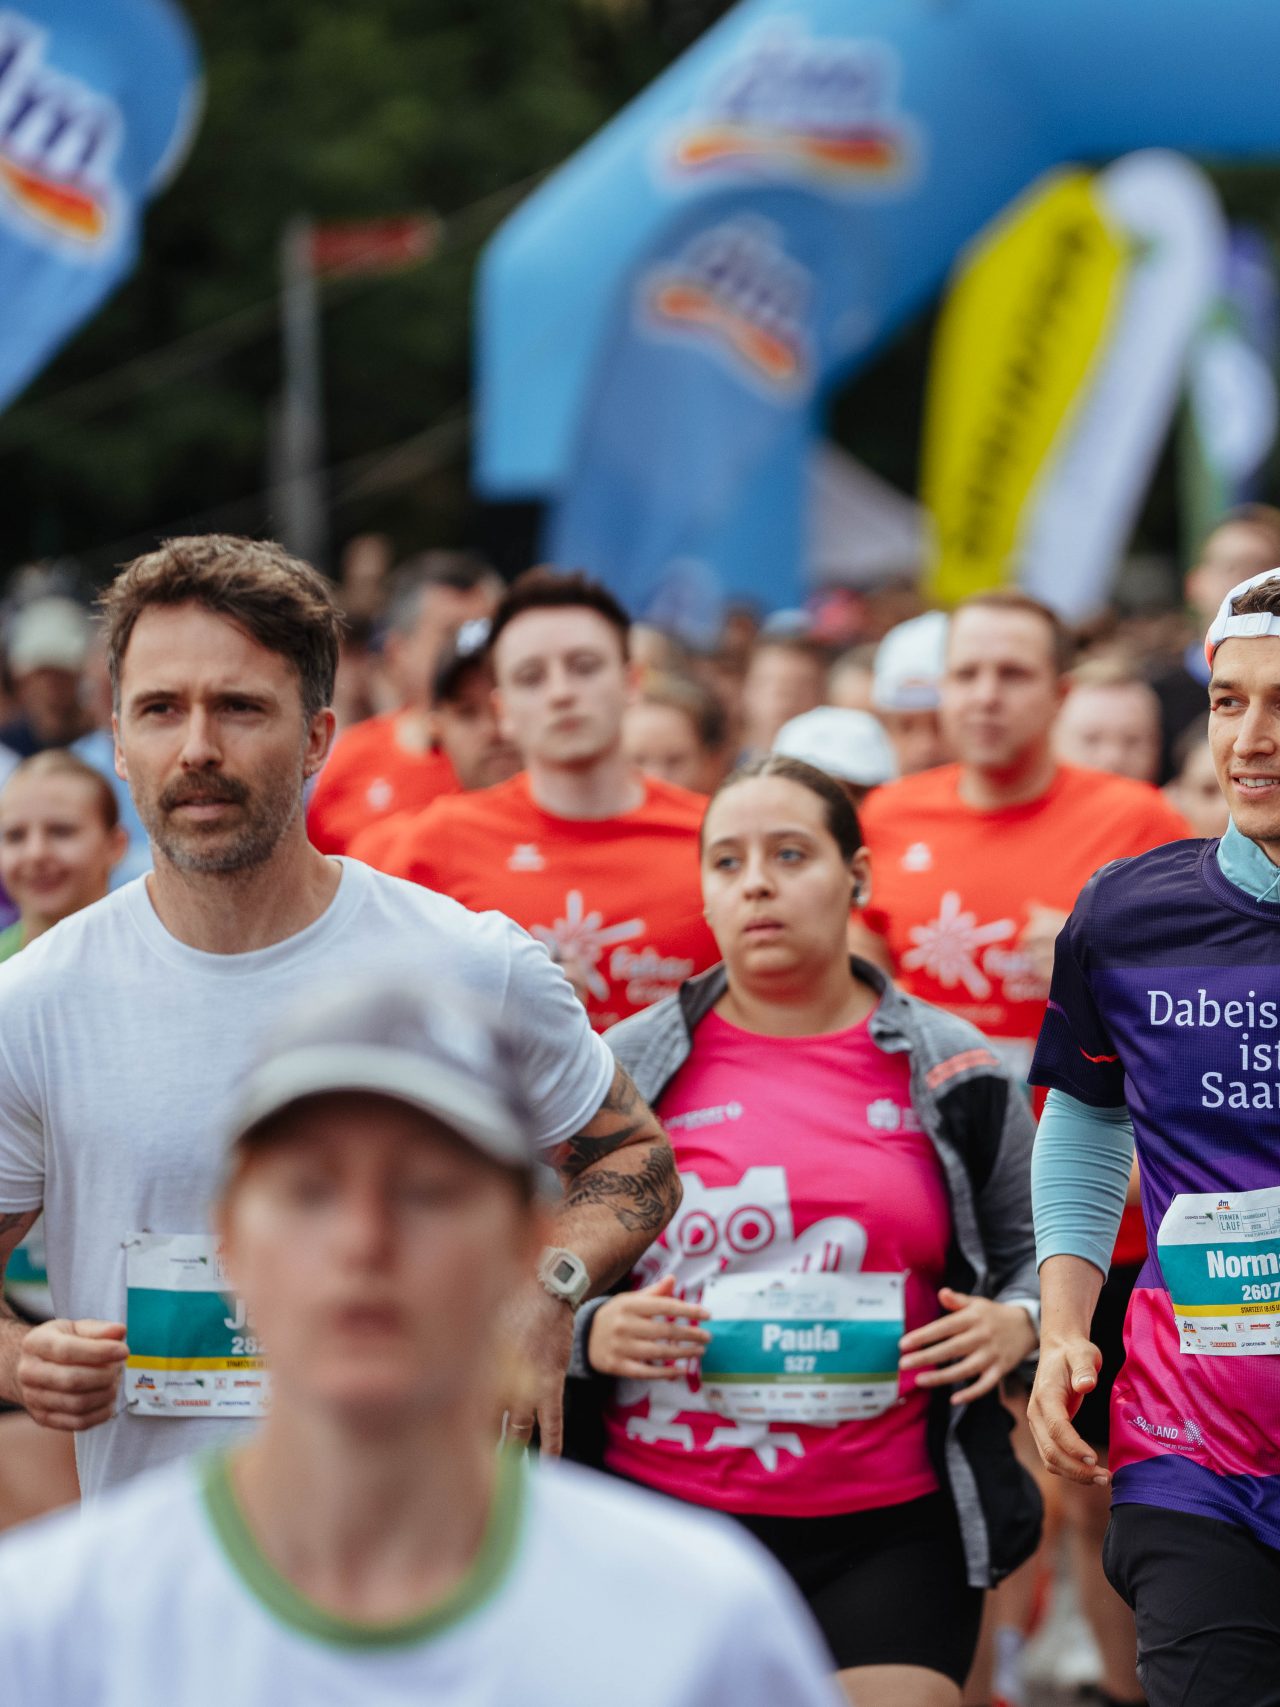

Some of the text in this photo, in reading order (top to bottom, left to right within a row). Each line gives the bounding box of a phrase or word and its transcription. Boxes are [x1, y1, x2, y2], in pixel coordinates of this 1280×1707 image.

[1221, 1221, 1241, 1231] LAUF
[1241, 1282, 1280, 1301] 2607
[762, 1323, 840, 1351] Paula
[784, 1356, 817, 1373] 527
